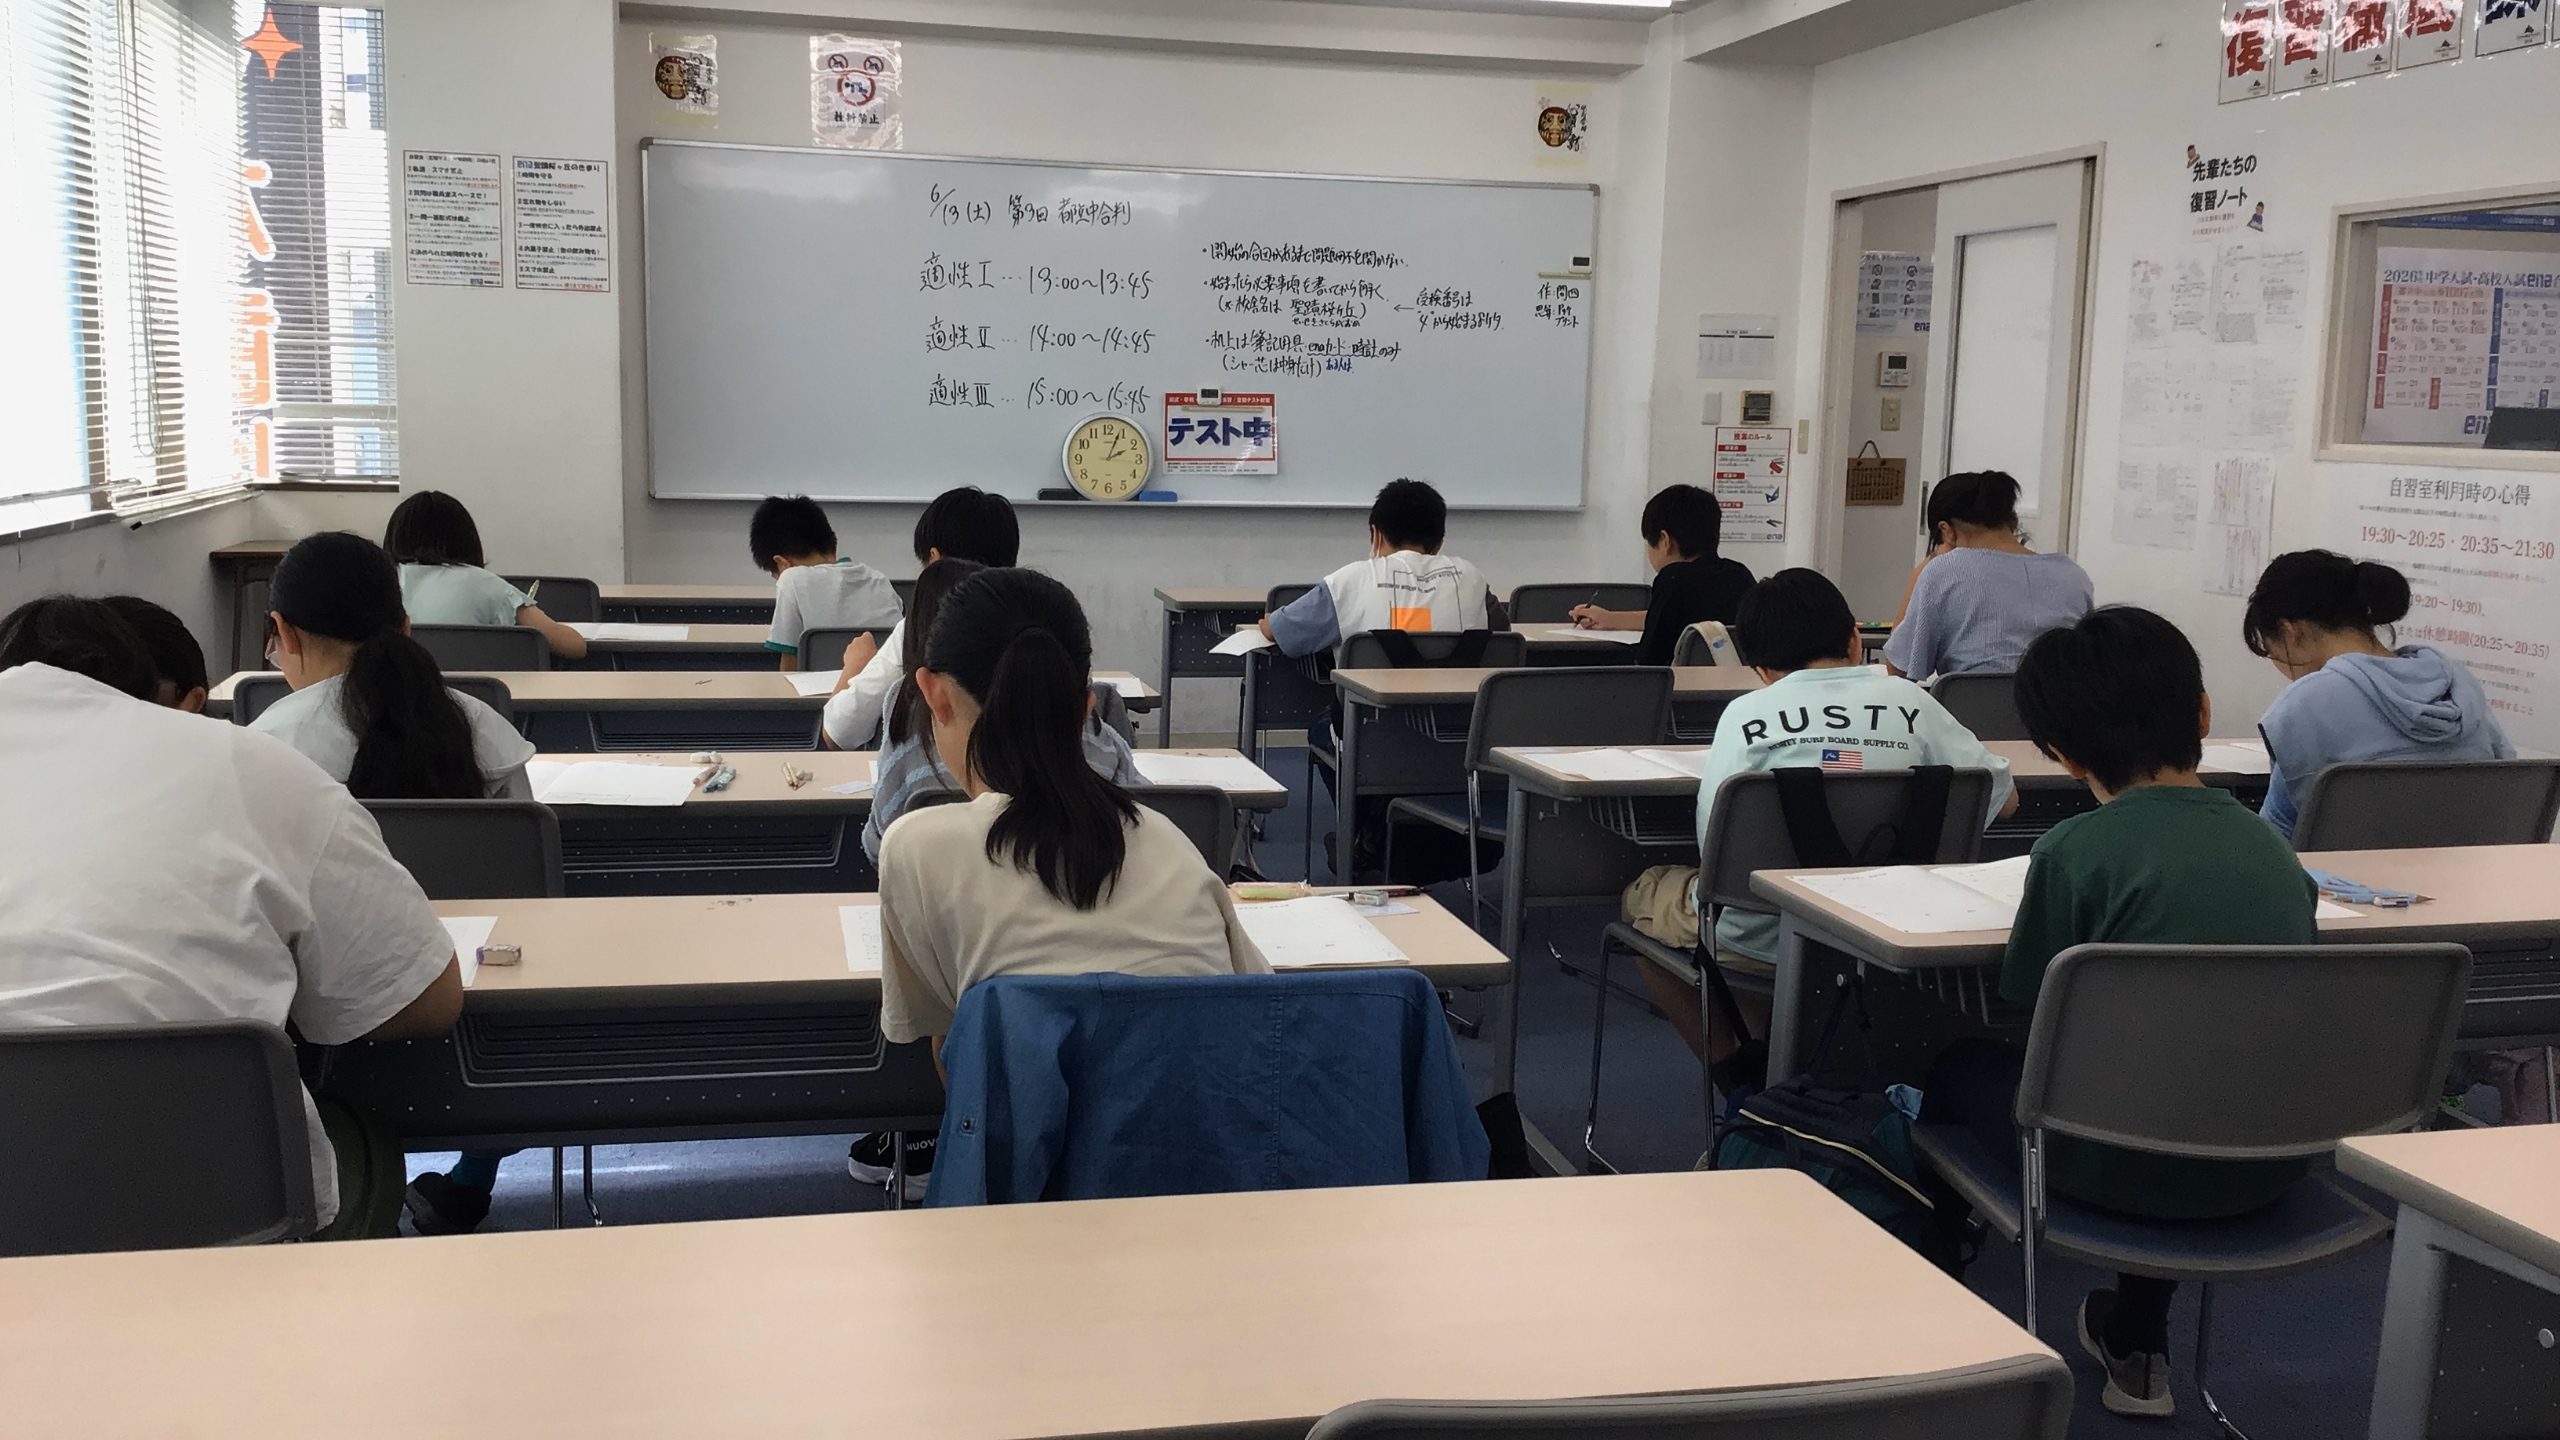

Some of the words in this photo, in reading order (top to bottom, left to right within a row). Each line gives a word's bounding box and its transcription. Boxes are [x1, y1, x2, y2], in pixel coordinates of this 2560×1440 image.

[2192, 154, 2257, 182] 先輩たちの
[2190, 186, 2248, 213] 復習ノート
[1008, 194, 1049, 228] 第3回
[1103, 424, 1114, 436] 12
[2464, 415, 2490, 434] en
[1089, 427, 1099, 439] 11
[1120, 428, 1127, 440] 1
[1168, 416, 1272, 446] テスト中
[1078, 438, 1090, 450] 10
[1130, 438, 1138, 450] 2
[1074, 453, 1083, 465] 9
[1135, 453, 1144, 464] 3
[1080, 468, 1088, 480] 8
[1129, 468, 1138, 480] 4
[1090, 479, 1098, 491] 7
[1104, 482, 1113, 494] 6
[1119, 479, 1127, 491] 5
[2390, 477, 2531, 506] 自習室利用時の心得
[1742, 705, 1920, 746] RUSTY
[1800, 737, 1825, 745] SURF
[1828, 737, 1859, 745] BOARD
[1864, 739, 1895, 749] SUPPLY
[906, 1138, 938, 1151] NUOV
